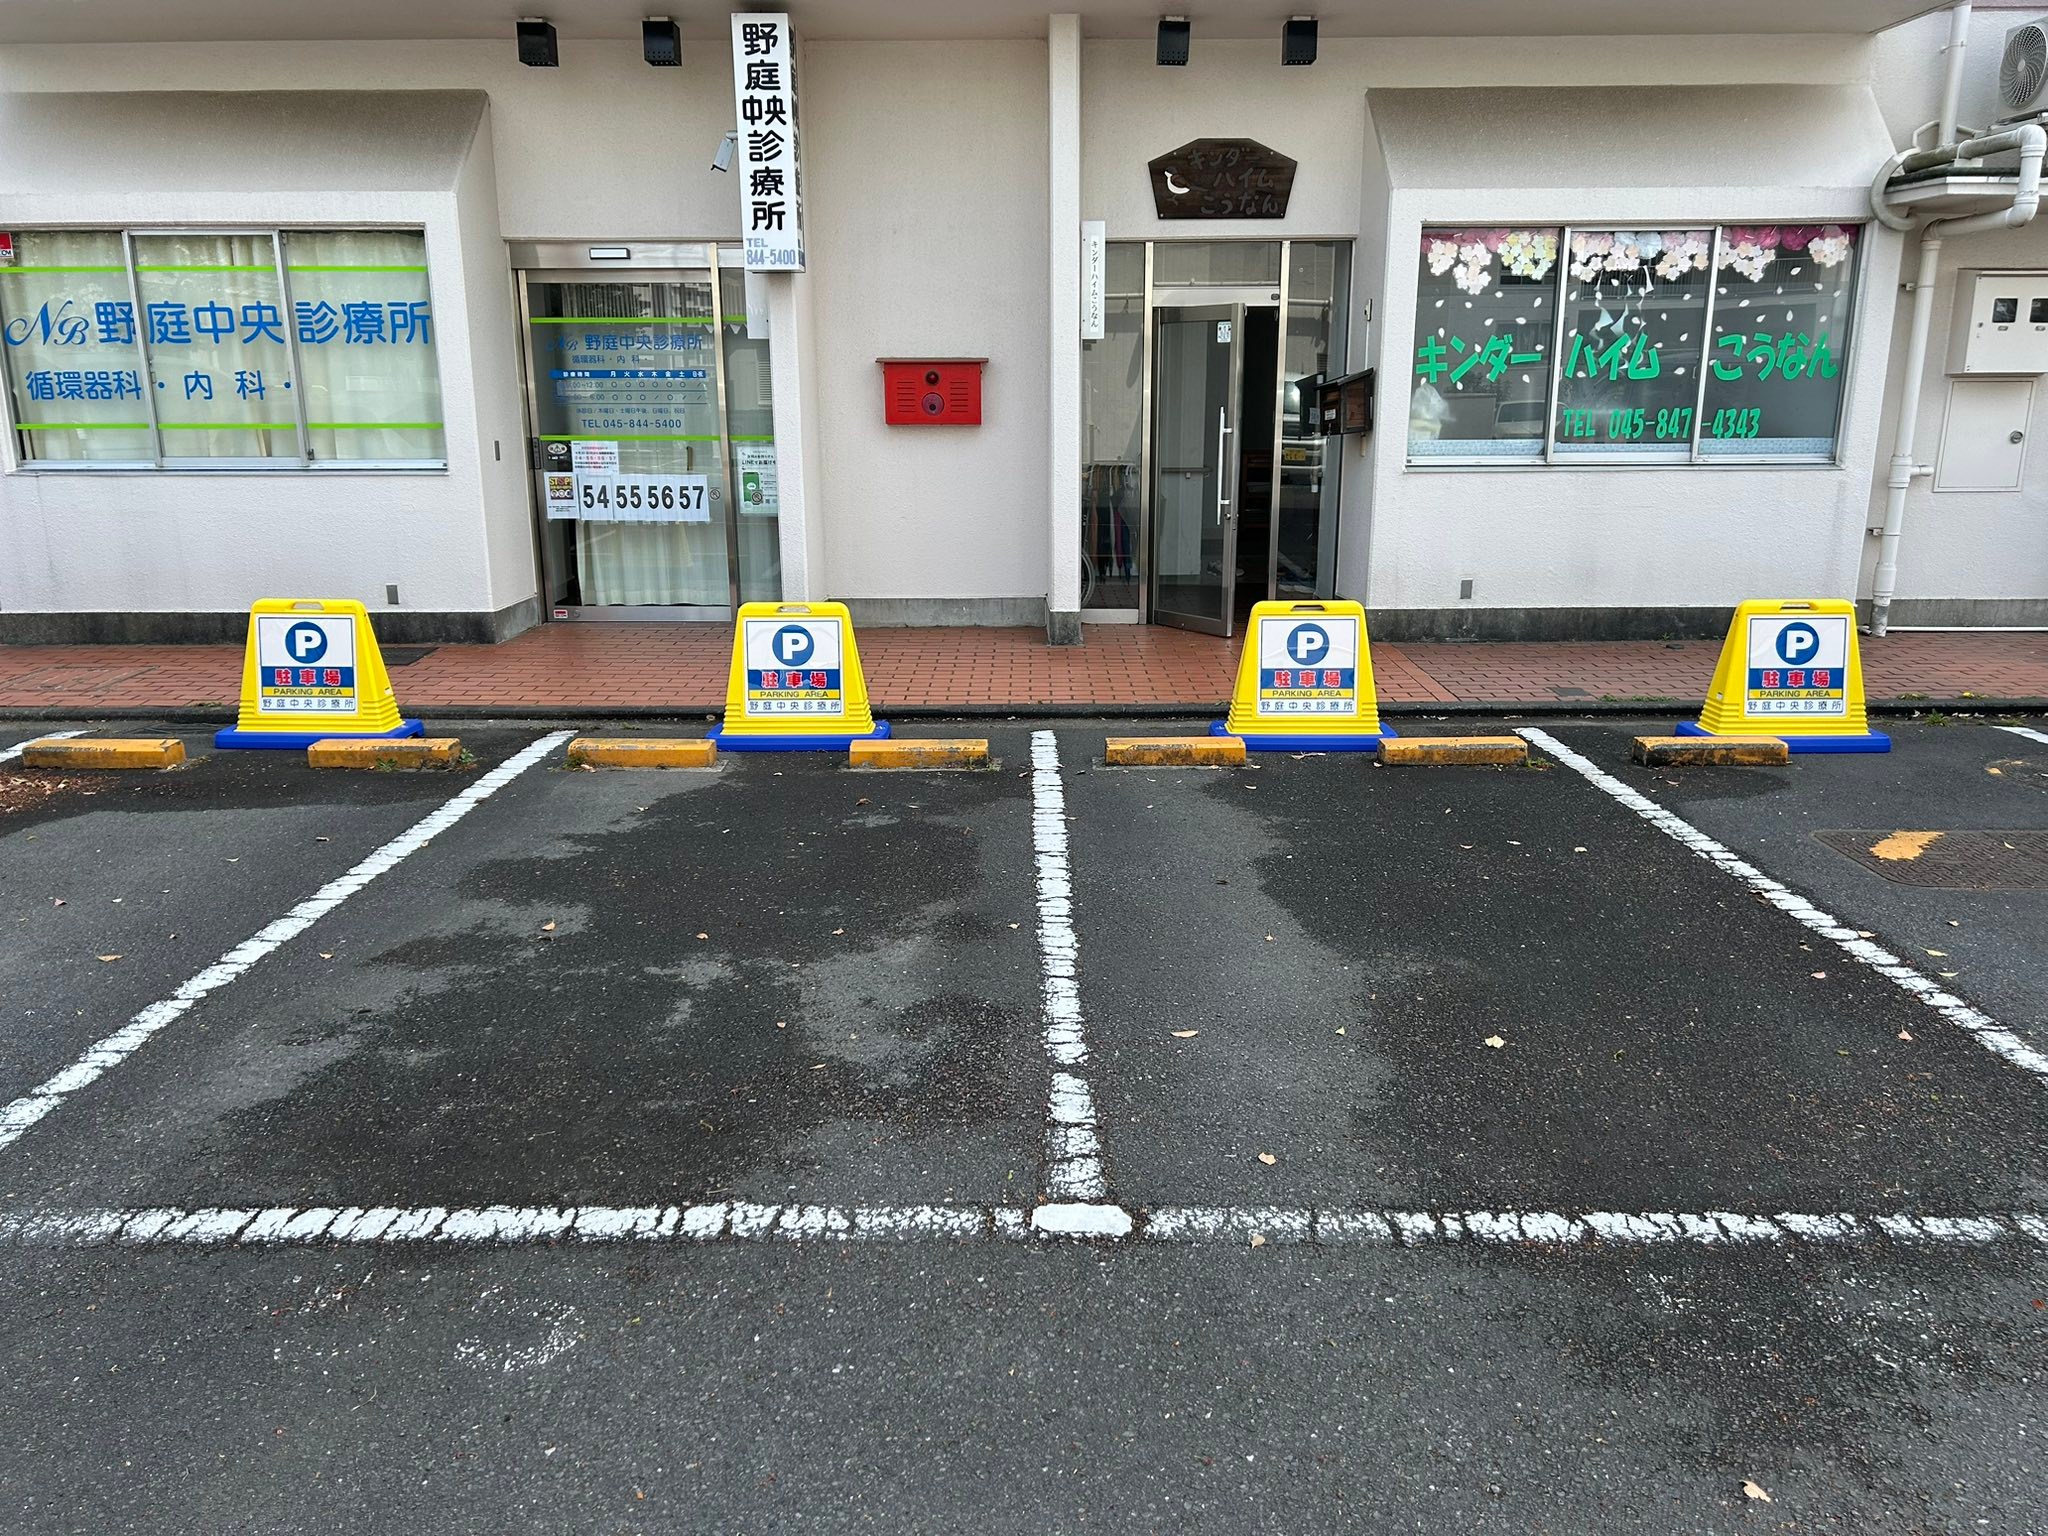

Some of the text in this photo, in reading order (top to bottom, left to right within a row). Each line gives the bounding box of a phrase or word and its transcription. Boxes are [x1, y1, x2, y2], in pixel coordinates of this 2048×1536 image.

[742, 22, 787, 231] 野庭中央診療所
[1187, 146, 1261, 170] キンダー
[1212, 167, 1275, 189] ハイム
[1200, 192, 1279, 215] こうなん
[746, 238, 768, 248] TEL
[746, 249, 796, 265] 844-5400
[1090, 241, 1099, 328] キンダーハイムこうなん
[95, 300, 430, 345] 野庭中央診療所
[585, 334, 703, 351] 野庭中央診療所
[1416, 331, 1838, 384] キンダー ハイム こうなん
[582, 419, 682, 429] TEL 045-844-5400
[1563, 407, 1762, 439] TEL 045-847-4343
[583, 485, 704, 510] 54 55 56 57
[295, 629, 322, 657] P
[782, 632, 809, 660] P
[1297, 631, 1324, 659] P
[1786, 630, 1814, 658] P
[275, 669, 341, 685] 駐車場
[761, 671, 827, 688] 駐車場
[1274, 670, 1341, 688] 駐車場
[1762, 670, 1830, 688] 駐車場
[273, 688, 343, 696] PARKING AREA
[760, 690, 829, 698] PARKING AREA
[262, 699, 354, 709] 野庭中央診療所
[749, 701, 840, 710] 野庭中央診療所
[1261, 701, 1353, 711] 野庭中央診療所
[1748, 701, 1842, 710] 野庭中央診療所
